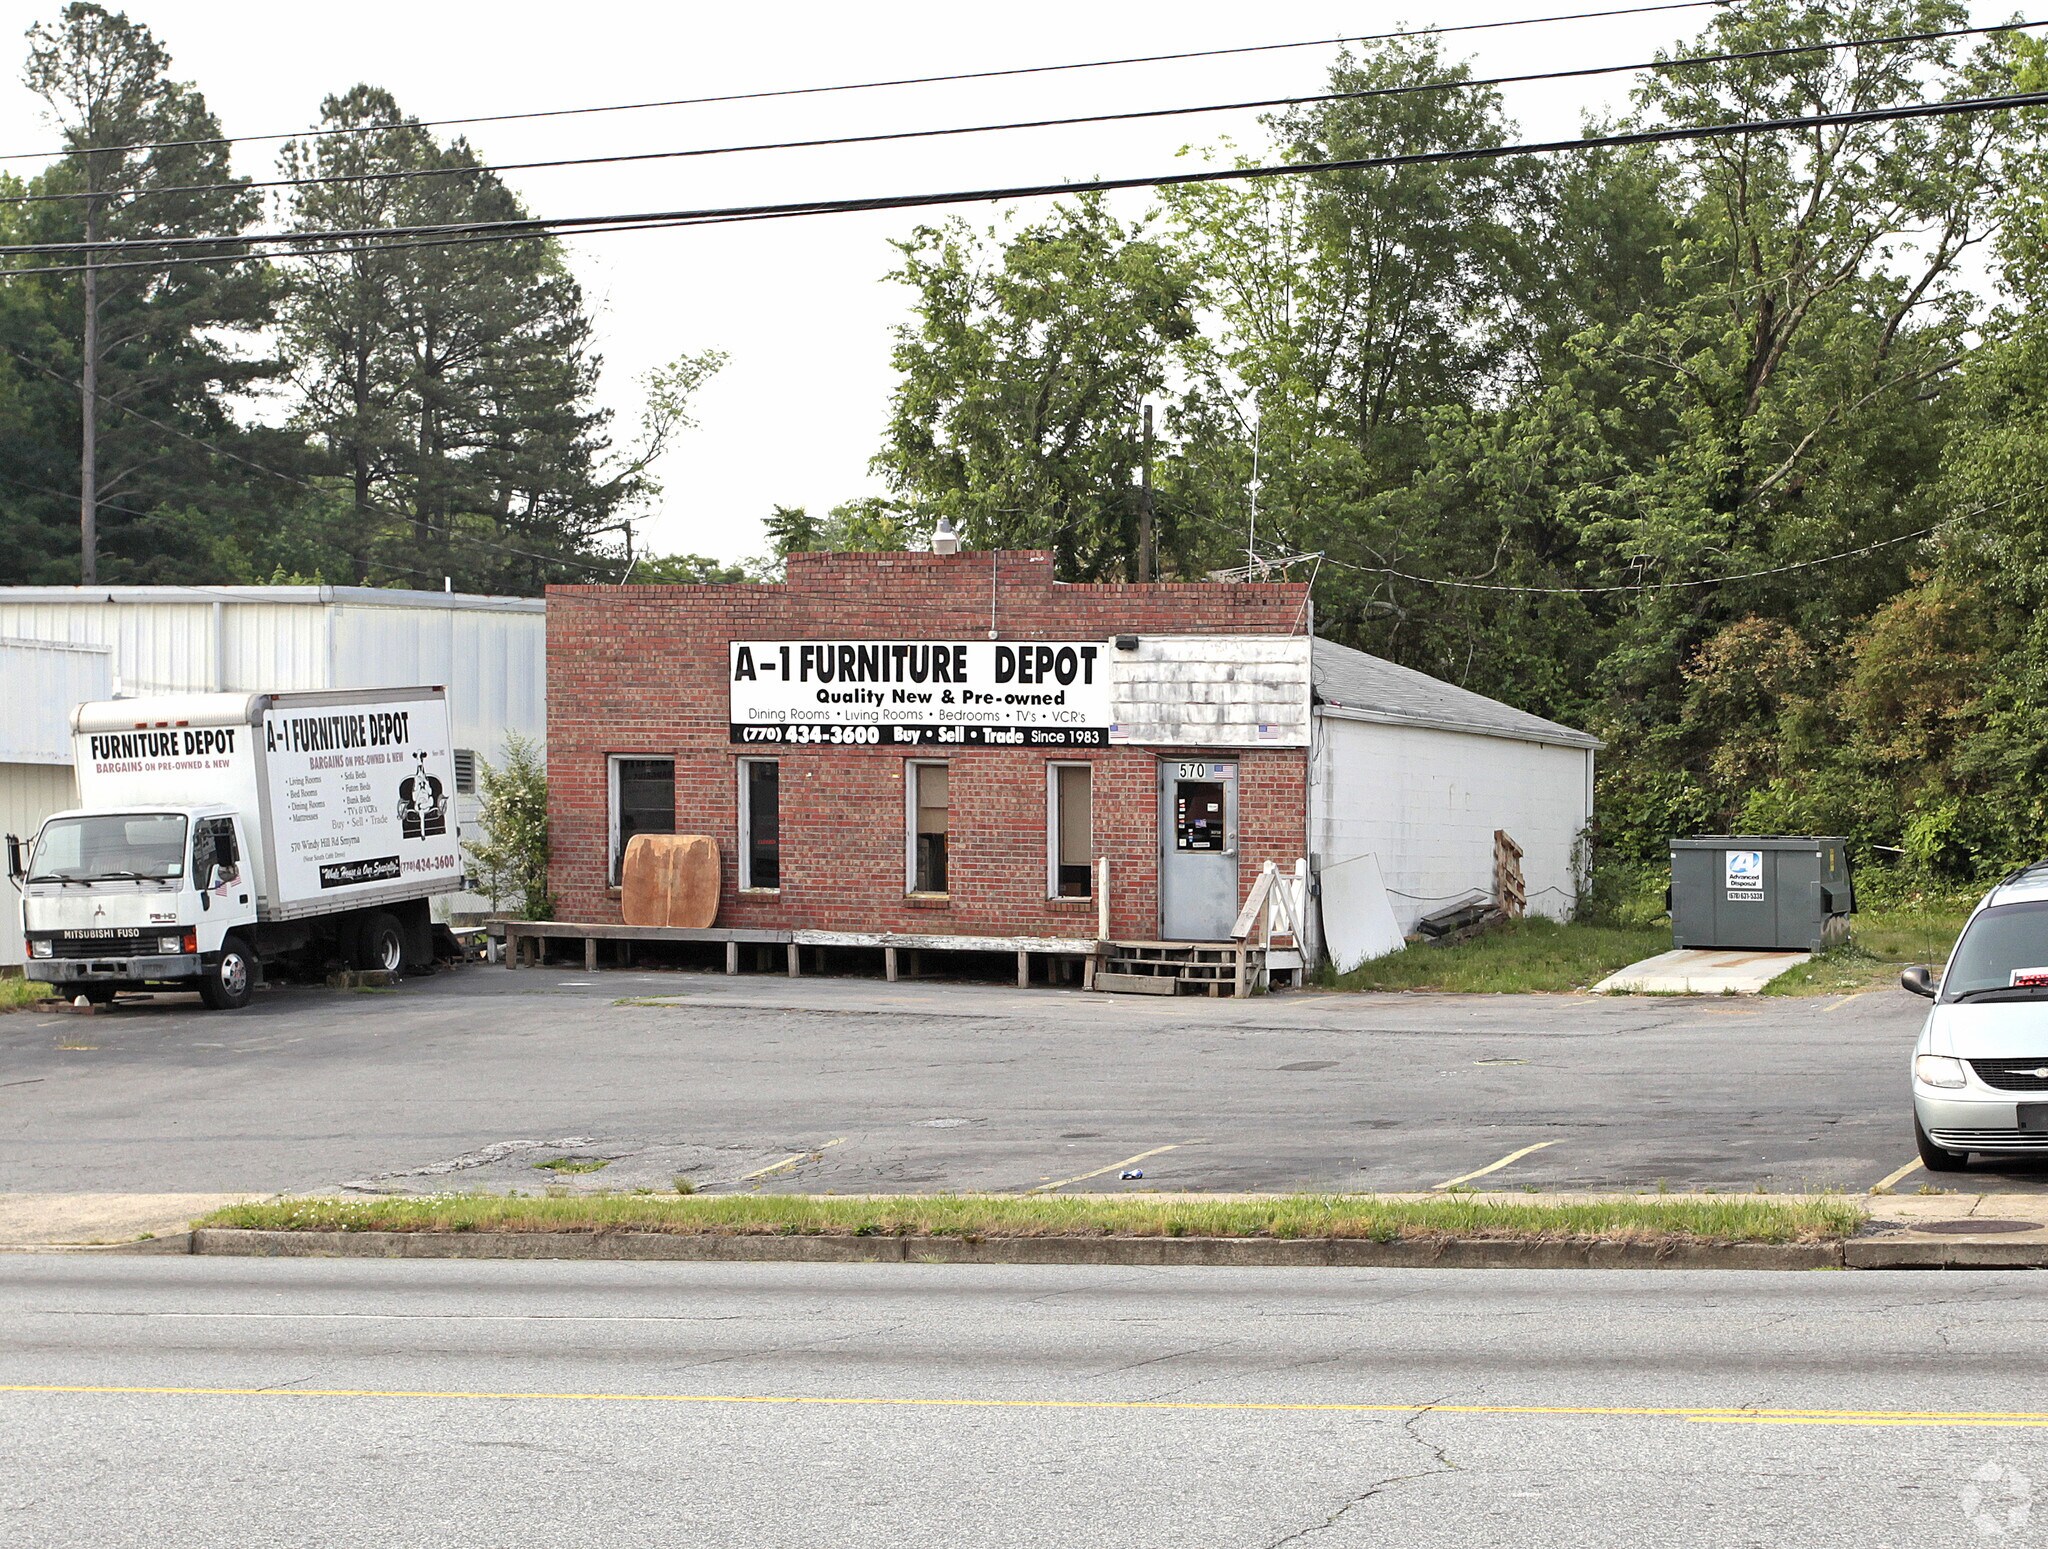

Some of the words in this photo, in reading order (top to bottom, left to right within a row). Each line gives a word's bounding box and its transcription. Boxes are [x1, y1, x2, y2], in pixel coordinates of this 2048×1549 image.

[734, 646, 790, 682] A-1
[800, 645, 967, 683] FURNITURE
[995, 646, 1098, 686] DEPOT
[816, 688, 885, 707] Quality
[892, 689, 933, 704] New
[941, 689, 955, 704] &
[963, 689, 1065, 705] Pre-owned
[748, 708, 786, 722] Dining
[790, 708, 830, 720] Rooms
[845, 709, 879, 723] Living
[883, 709, 923, 721] Rooms
[939, 709, 1000, 722] Bedrooms
[1016, 710, 1037, 722] TV's
[1052, 711, 1086, 723] VCR's
[267, 719, 290, 753] A-1
[292, 714, 367, 753] FURNITURE
[368, 711, 409, 746] DEPOT
[743, 727, 782, 742] (770)
[785, 725, 880, 744] 434-3600
[893, 726, 922, 745] Buy
[938, 726, 965, 743] Sell
[982, 727, 1024, 744] Trade
[1031, 730, 1066, 743] Since
[1069, 730, 1099, 744] 1983
[91, 732, 179, 760] FURNITURE
[184, 729, 235, 755] DEPOT
[96, 761, 143, 774] BARGAINS
[145, 763, 156, 771] ON
[158, 760, 202, 771] PRE-OWNED
[205, 760, 211, 769] &
[213, 759, 230, 768] NEW
[309, 754, 345, 770] BARGAINS
[345, 756, 354, 767] ON
[354, 753, 385, 767] PRE-OWNED
[386, 752, 391, 763] &
[392, 752, 404, 763] NEW
[344, 771, 355, 781] Sofa
[355, 770, 367, 780] Beds
[1179, 763, 1205, 778] 570
[289, 776, 304, 787] Living
[305, 775, 322, 785] Rooms
[360, 782, 371, 791] Beds
[290, 789, 300, 799] Bed
[301, 788, 318, 798] Rooms
[360, 794, 372, 804] Beds
[291, 801, 308, 811] Dining
[309, 800, 326, 809] Rooms
[292, 813, 319, 823] Mattresses
[331, 819, 345, 831] Buy
[351, 816, 364, 828] Sell
[371, 814, 388, 825] Trade
[291, 842, 301, 853] 570
[301, 840, 320, 852] Windy
[320, 837, 331, 849] Hill
[331, 836, 340, 847] Rd
[339, 835, 361, 847] Smyrna
[64, 929, 114, 940] MITSUBISHI
[117, 928, 140, 938] FUSO
